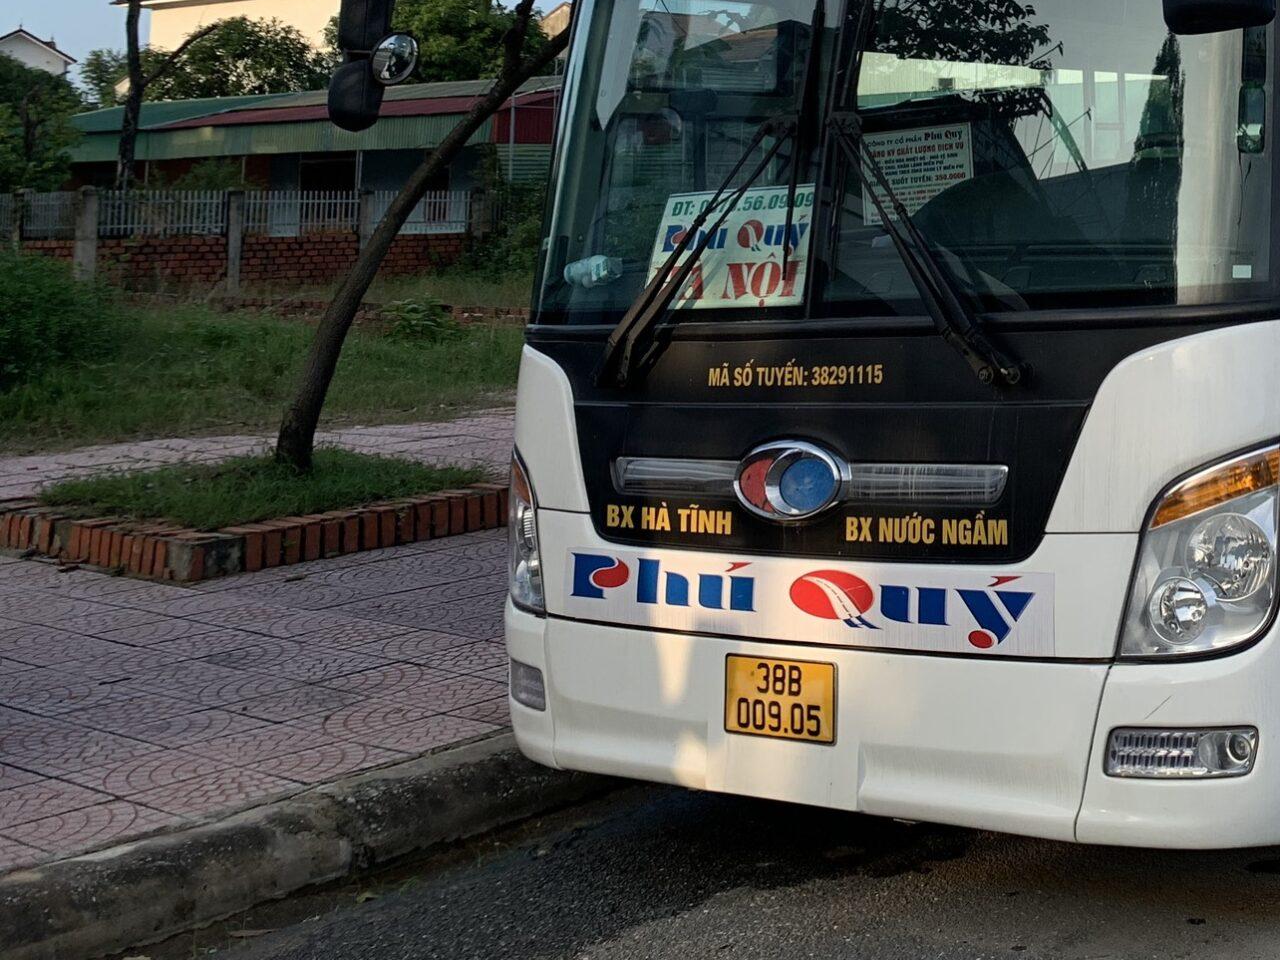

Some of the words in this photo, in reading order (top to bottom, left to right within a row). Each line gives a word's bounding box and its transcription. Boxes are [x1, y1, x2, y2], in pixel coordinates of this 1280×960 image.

[722, 252, 802, 307] NỘI
[708, 362, 731, 387] MÃ
[733, 358, 755, 387] SỐ
[756, 358, 809, 387] TUYẾN:
[811, 364, 884, 387] 38291115
[606, 503, 635, 529] BX
[641, 501, 671, 531] HÀ
[677, 503, 733, 536] TĨNH
[845, 516, 873, 543] BX
[879, 511, 935, 546] NƯỚC
[942, 510, 1009, 546] NGẦM
[569, 551, 757, 613] Phú
[789, 569, 1036, 650] Quý
[756, 662, 802, 697] 38B
[737, 697, 821, 737] 009.05
